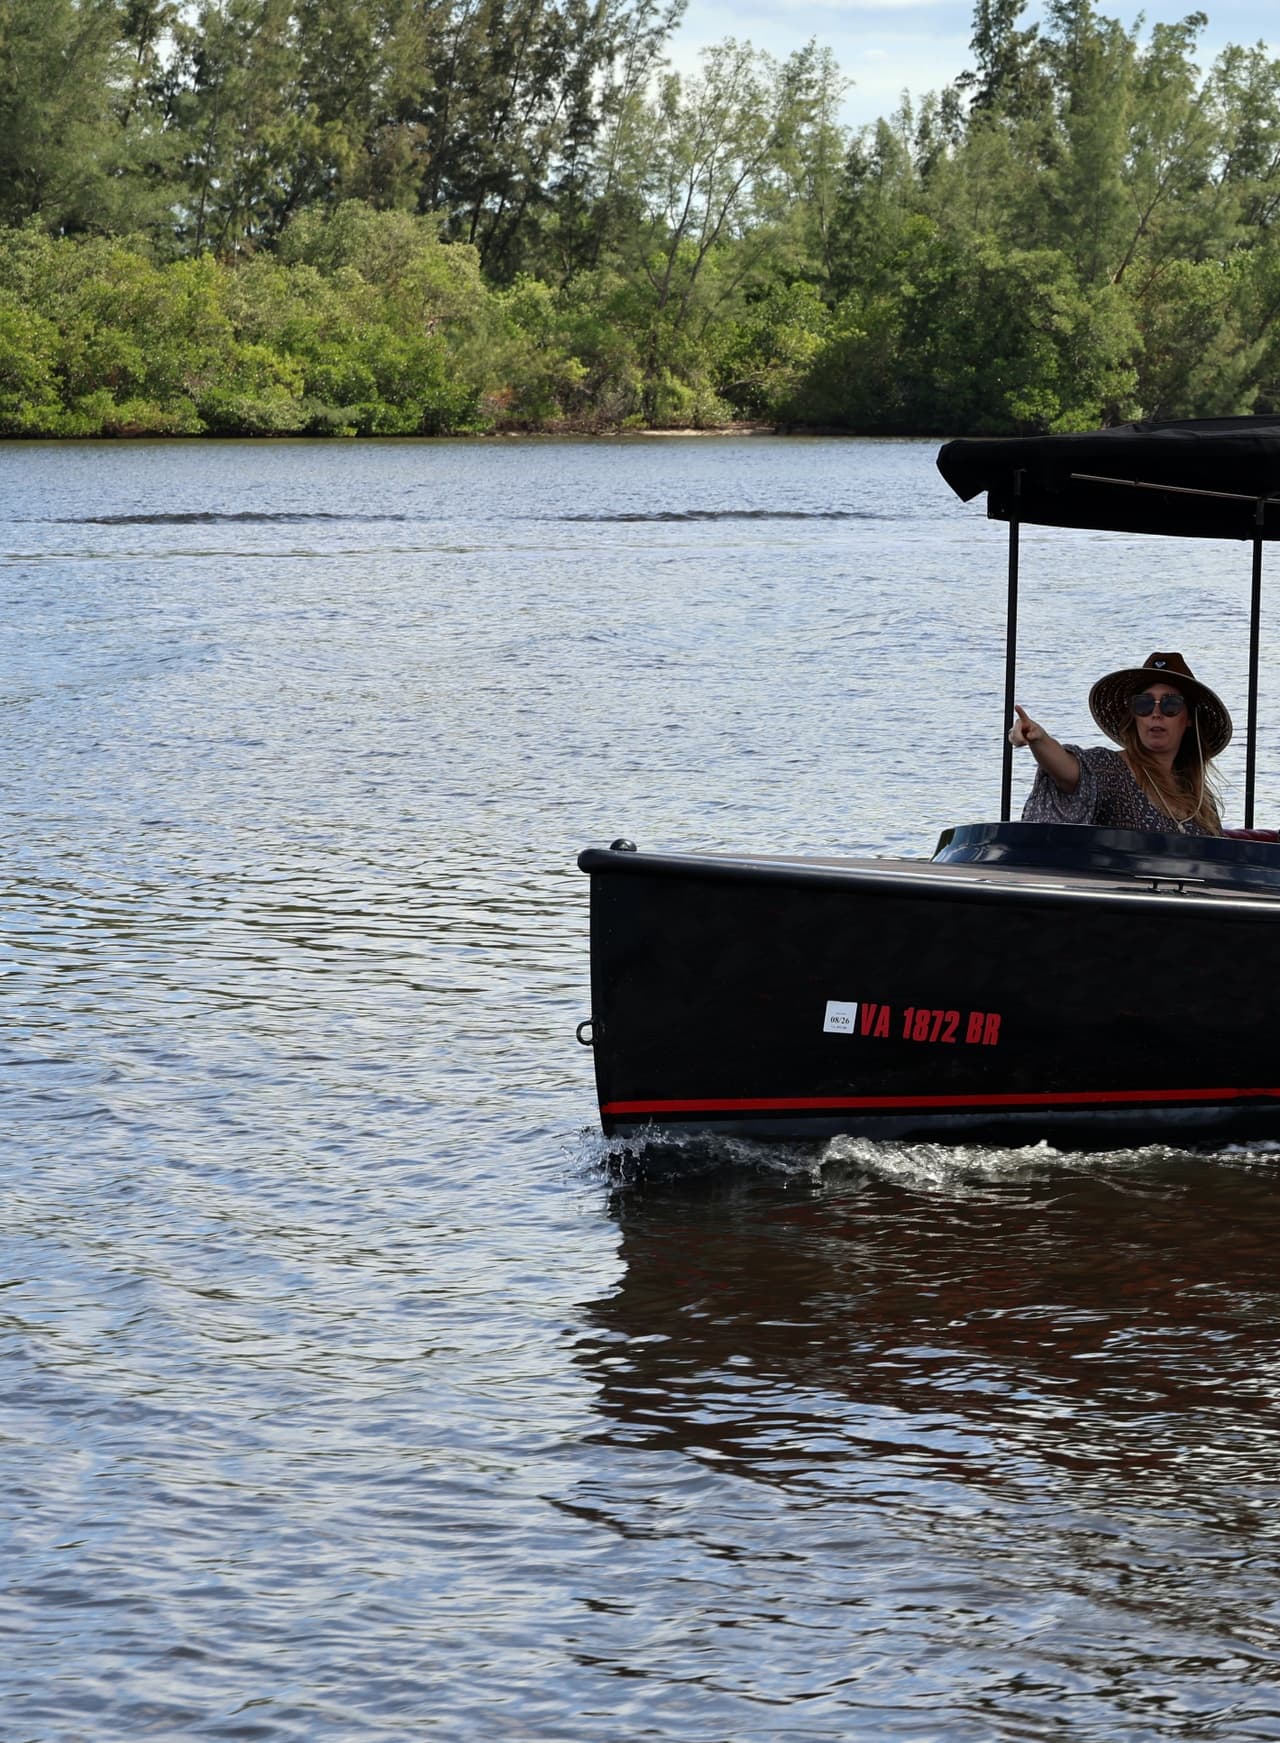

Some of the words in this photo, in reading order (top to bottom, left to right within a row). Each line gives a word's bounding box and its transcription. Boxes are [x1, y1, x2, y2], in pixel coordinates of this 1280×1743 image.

[860, 1003, 890, 1038] VA
[903, 1007, 961, 1042] 1872
[965, 1012, 1001, 1045] BR
